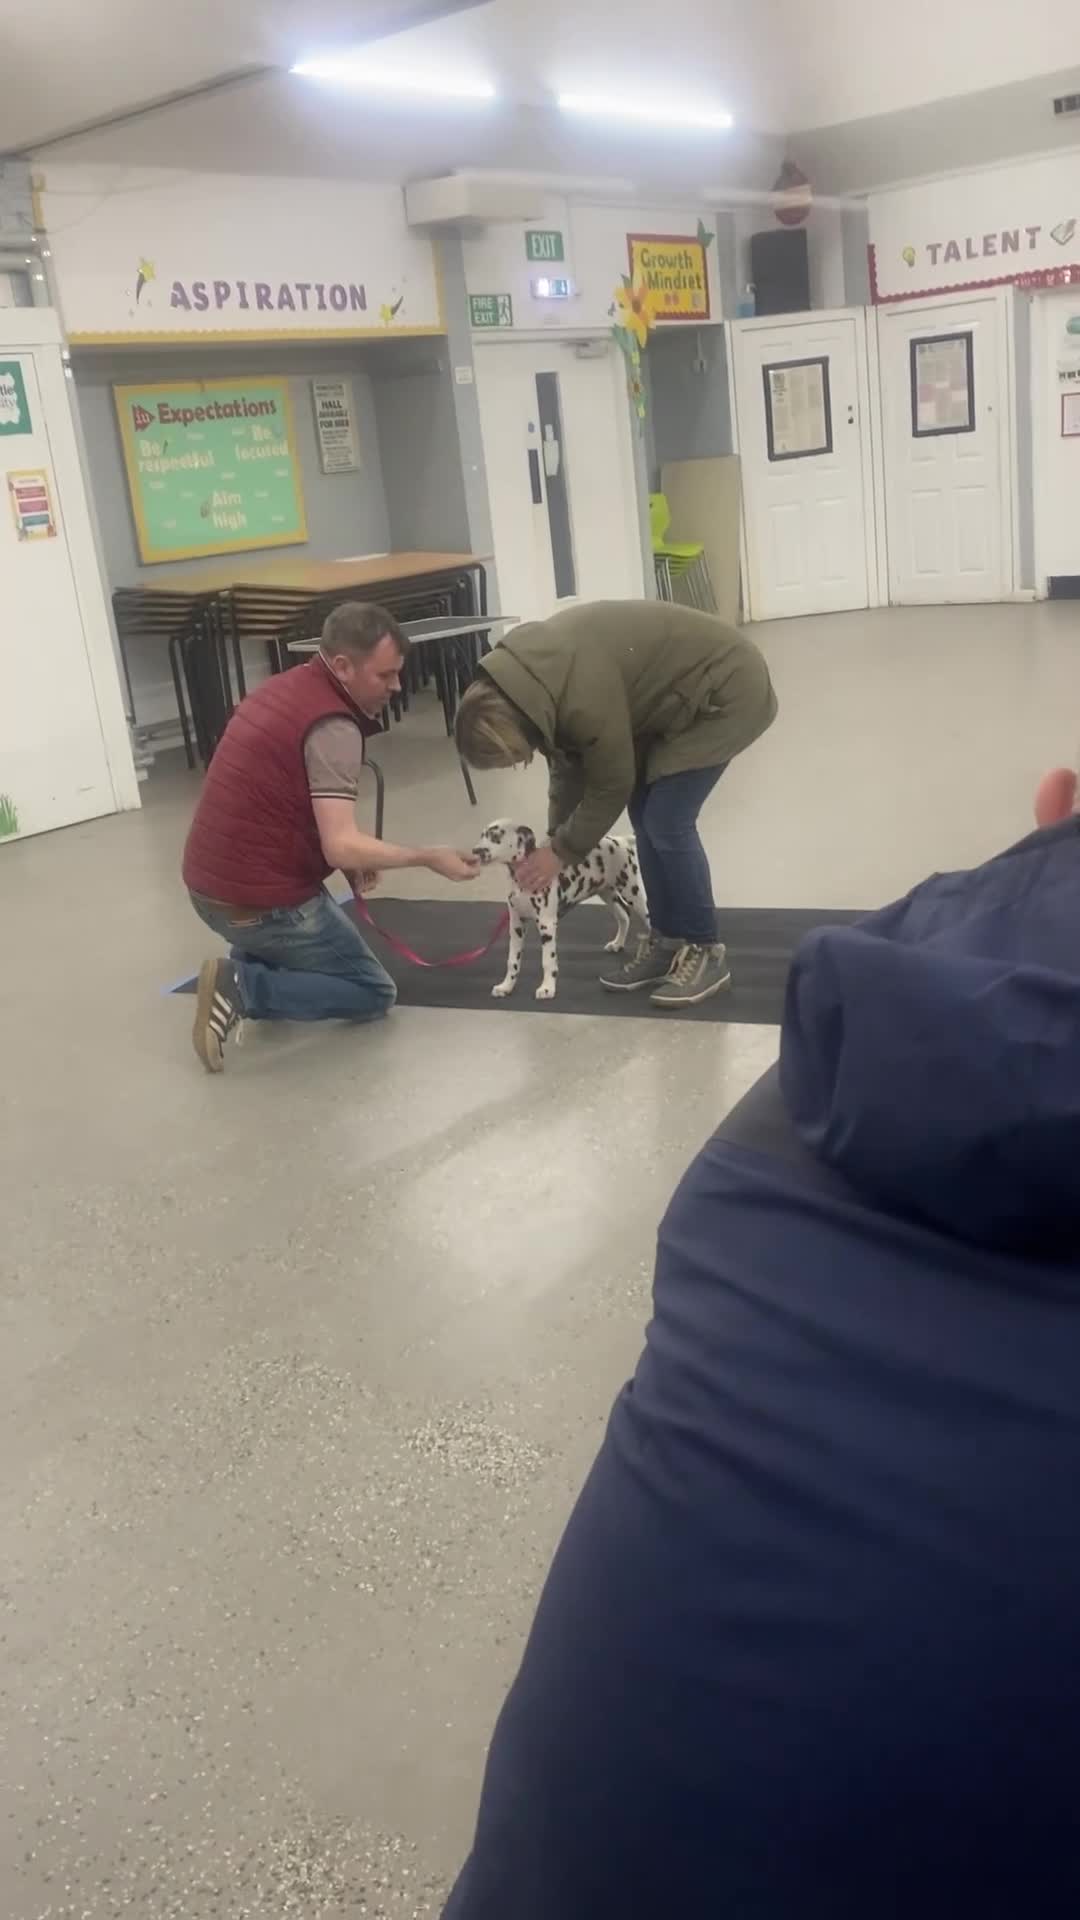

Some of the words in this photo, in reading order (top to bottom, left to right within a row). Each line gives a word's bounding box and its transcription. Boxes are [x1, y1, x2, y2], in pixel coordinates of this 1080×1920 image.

[531, 233, 556, 257] EXIT
[926, 226, 1041, 265] TALENT
[641, 247, 694, 270] Growth
[647, 270, 702, 290] Mindset
[170, 280, 367, 311] ASPIRATION
[473, 297, 493, 310] FIRE
[474, 310, 495, 324] EXIT
[157, 397, 277, 427] Expectations
[321, 400, 343, 409] HALL
[251, 424, 273, 441] Be
[139, 439, 161, 457] Be
[138, 449, 216, 474] respectful
[212, 490, 242, 507] Aim
[212, 511, 247, 530] high
